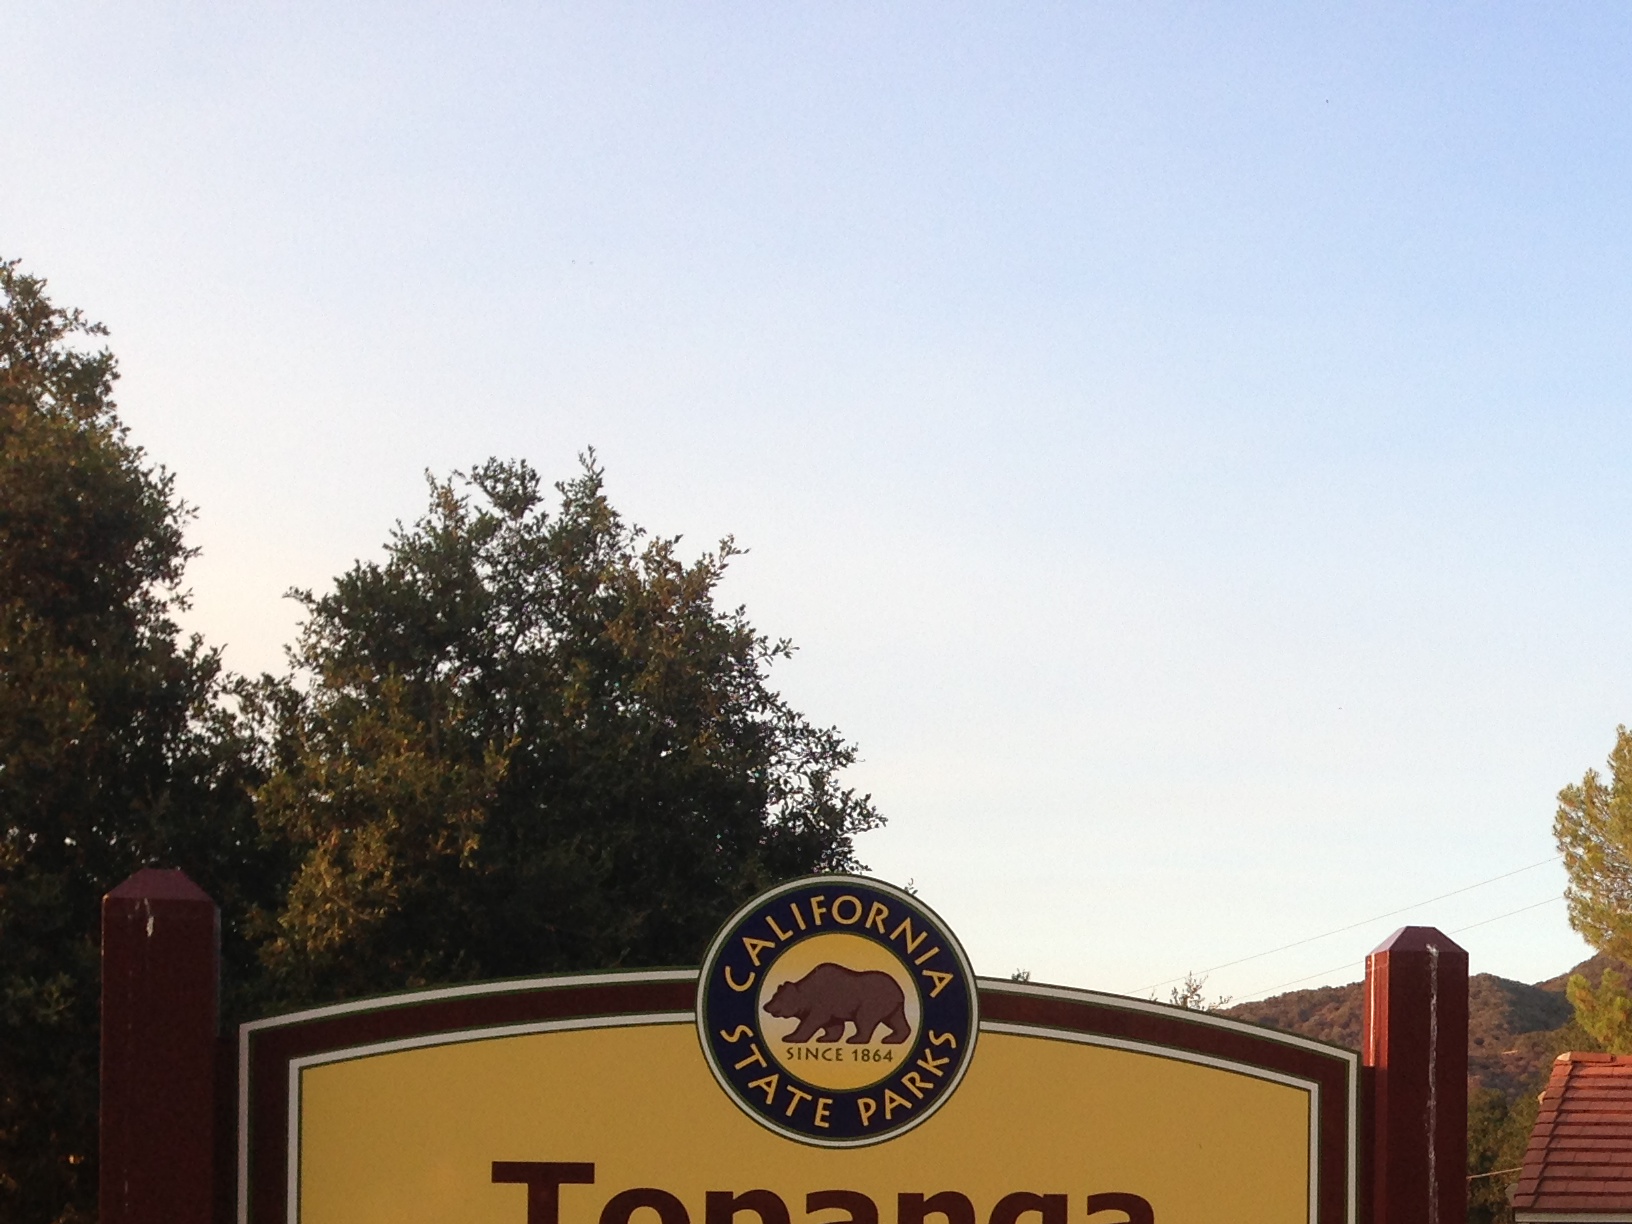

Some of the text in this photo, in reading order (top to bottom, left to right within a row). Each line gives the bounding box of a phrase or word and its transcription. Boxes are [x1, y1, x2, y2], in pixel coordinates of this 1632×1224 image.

[725, 895, 954, 998] CALIFORNIA
[720, 1023, 957, 1128] STATE PARKS
[786, 1047, 894, 1062] SINCE 1864
